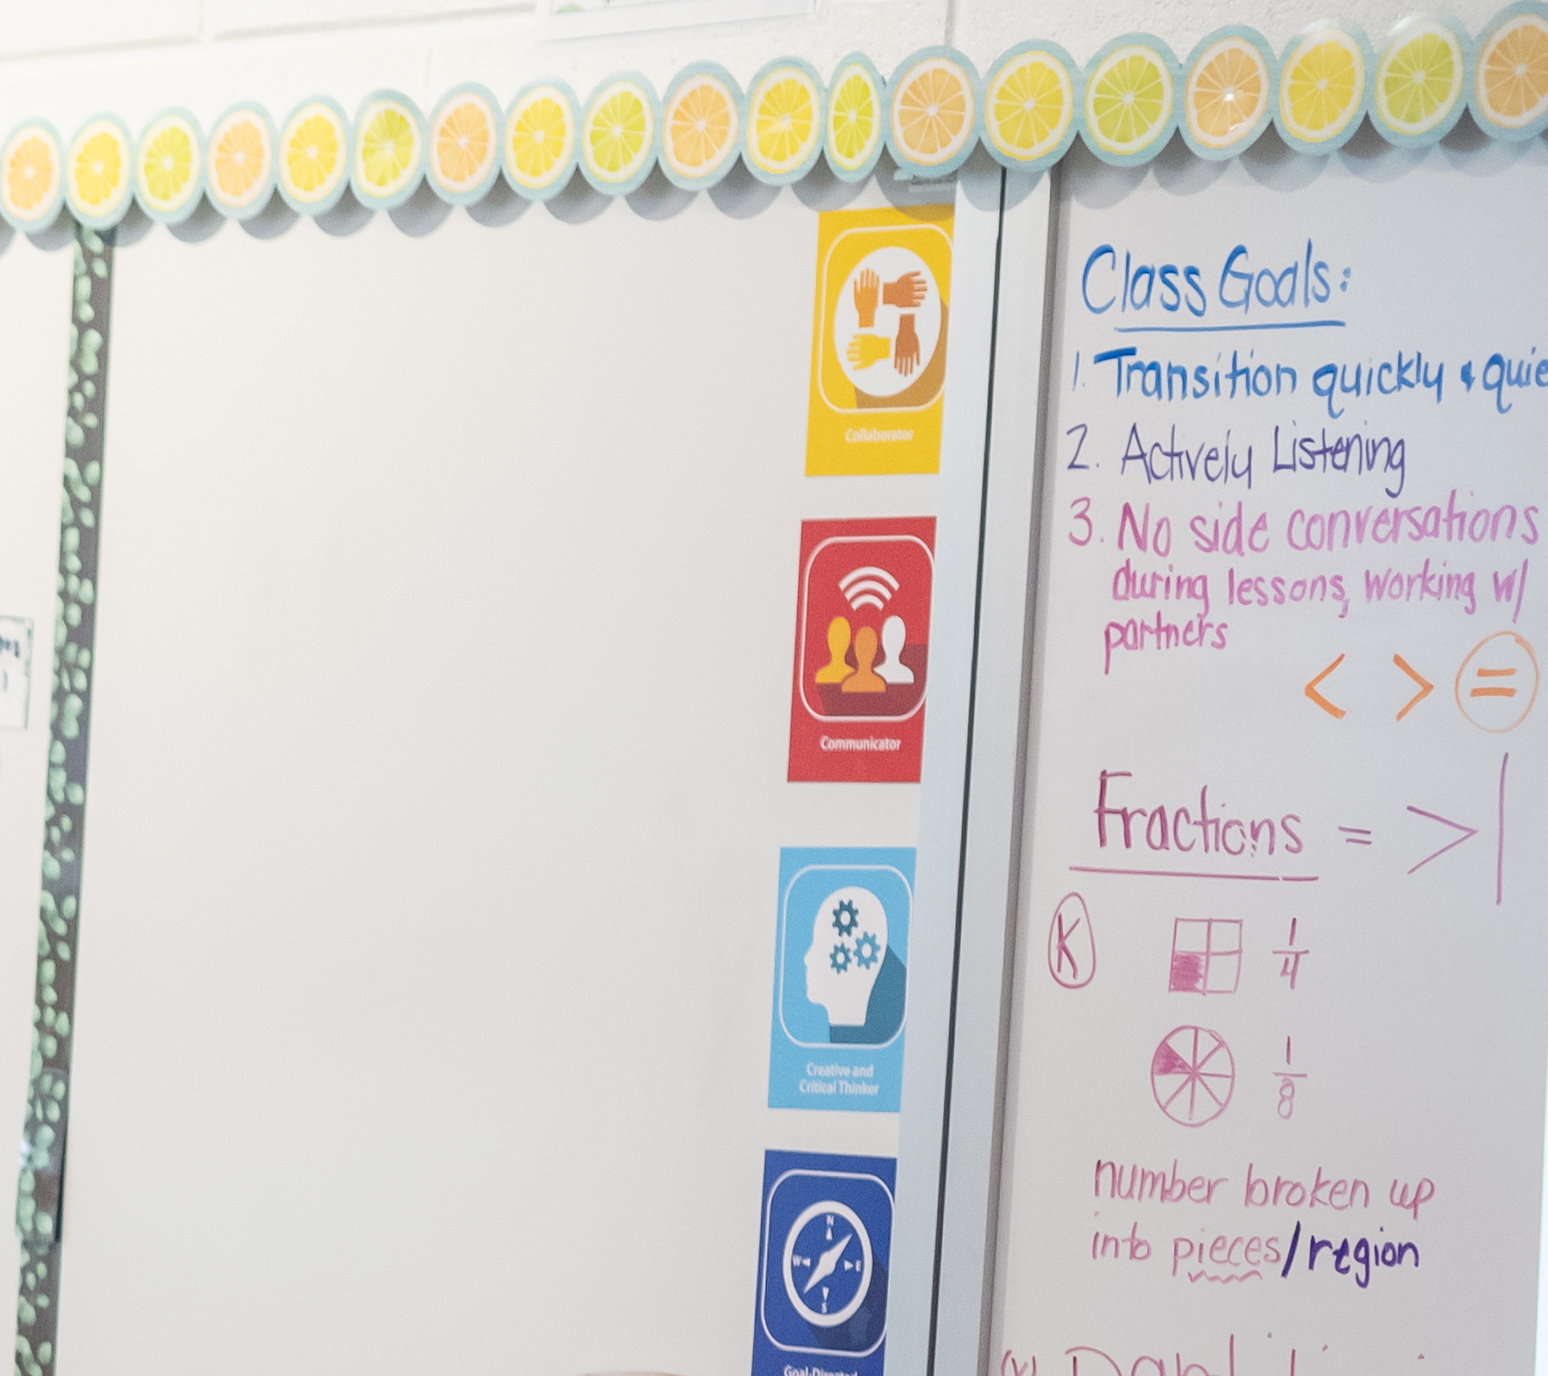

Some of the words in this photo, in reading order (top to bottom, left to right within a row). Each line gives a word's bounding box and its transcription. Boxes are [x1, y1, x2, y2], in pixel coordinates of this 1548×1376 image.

[1082, 244, 1207, 317] Class
[1219, 238, 1352, 314] Goals:
[1094, 347, 1297, 402] Transition
[1312, 350, 1444, 419] quickly
[845, 426, 914, 445] Collaborator
[1121, 422, 1254, 489] Actively
[1273, 420, 1406, 499] Listening
[1117, 502, 1171, 558] No
[1190, 500, 1271, 557] side
[1286, 489, 1541, 554] conversations
[1112, 558, 1211, 619] during
[1228, 567, 1350, 620] lessons,
[1364, 558, 1477, 616] working
[1104, 611, 1229, 676] partners
[820, 734, 902, 755] Communicator
[1093, 769, 1304, 856] Fractions
[799, 1078, 837, 1096] Critical
[839, 1080, 880, 1097] Thinker
[806, 1063, 852, 1079] Creative
[854, 1065, 874, 1079] and
[1093, 1157, 1229, 1205] number
[1244, 1162, 1371, 1210] broken
[1389, 1177, 1436, 1221] up
[1092, 1210, 1151, 1261] into
